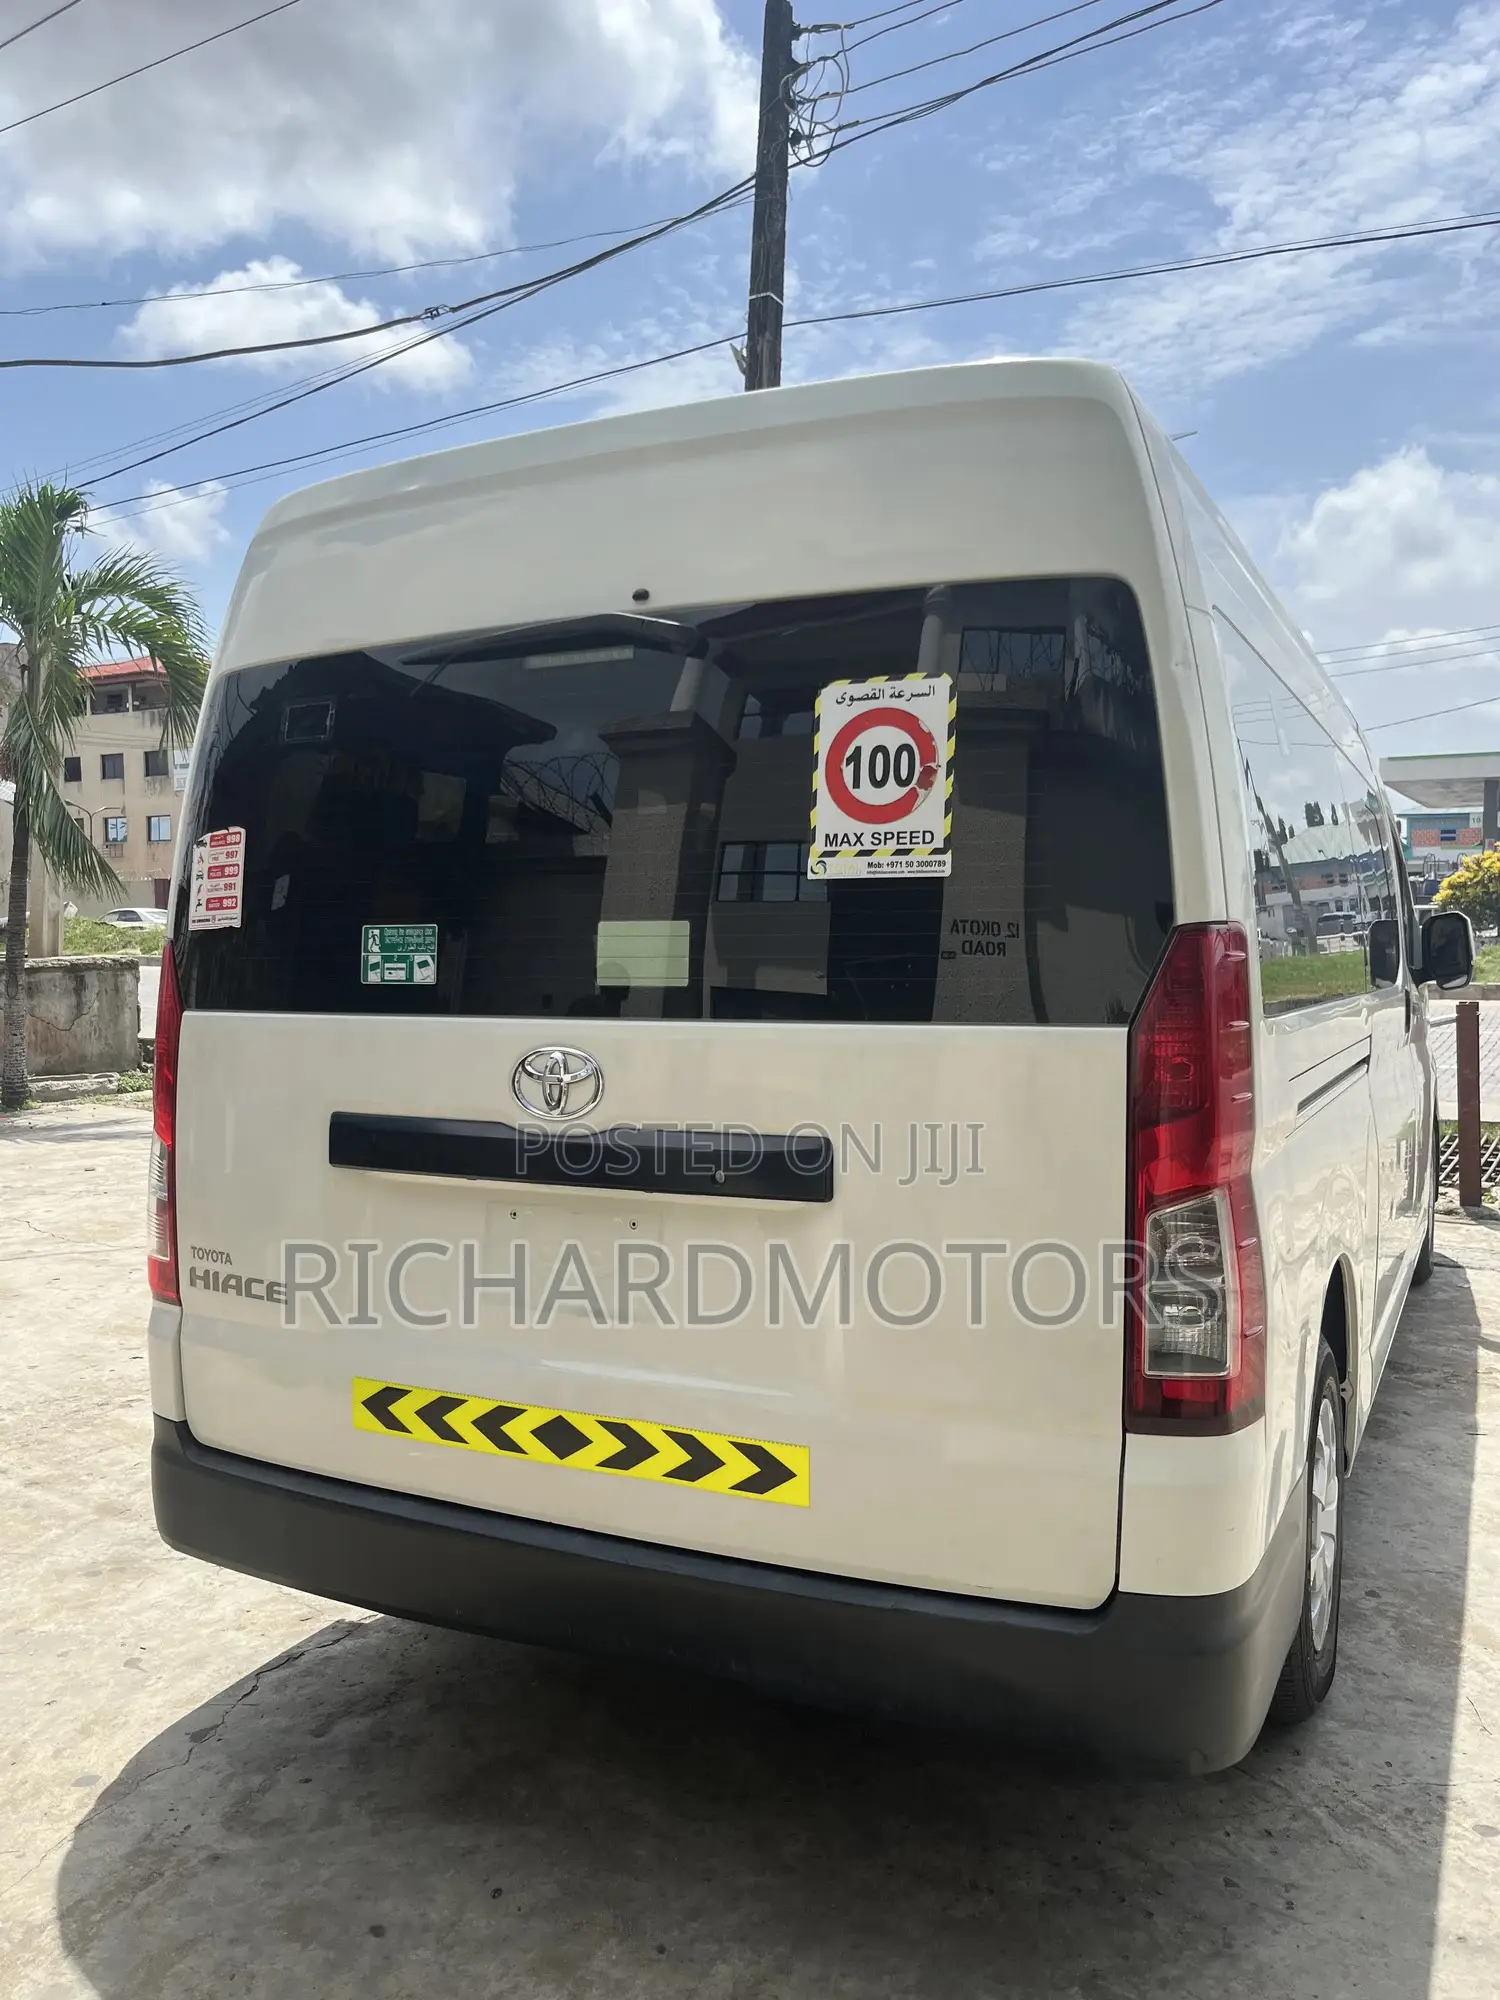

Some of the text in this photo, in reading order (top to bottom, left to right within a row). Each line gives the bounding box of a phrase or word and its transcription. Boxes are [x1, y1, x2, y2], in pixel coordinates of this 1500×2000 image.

[836, 685, 935, 707] السرعة القصوى
[845, 743, 915, 789] 100
[226, 834, 240, 844] 998
[824, 830, 934, 847] MAX SPEED
[225, 850, 238, 859] 997
[868, 861, 884, 869] Mob:
[886, 861, 903, 869] +971
[905, 860, 913, 868] 50
[916, 860, 946, 868] 3000789
[224, 866, 238, 875] 999
[223, 882, 236, 891] 991
[223, 898, 236, 907] 992
[191, 1246, 232, 1265] TOYOTA
[189, 1266, 288, 1305] HIACE
